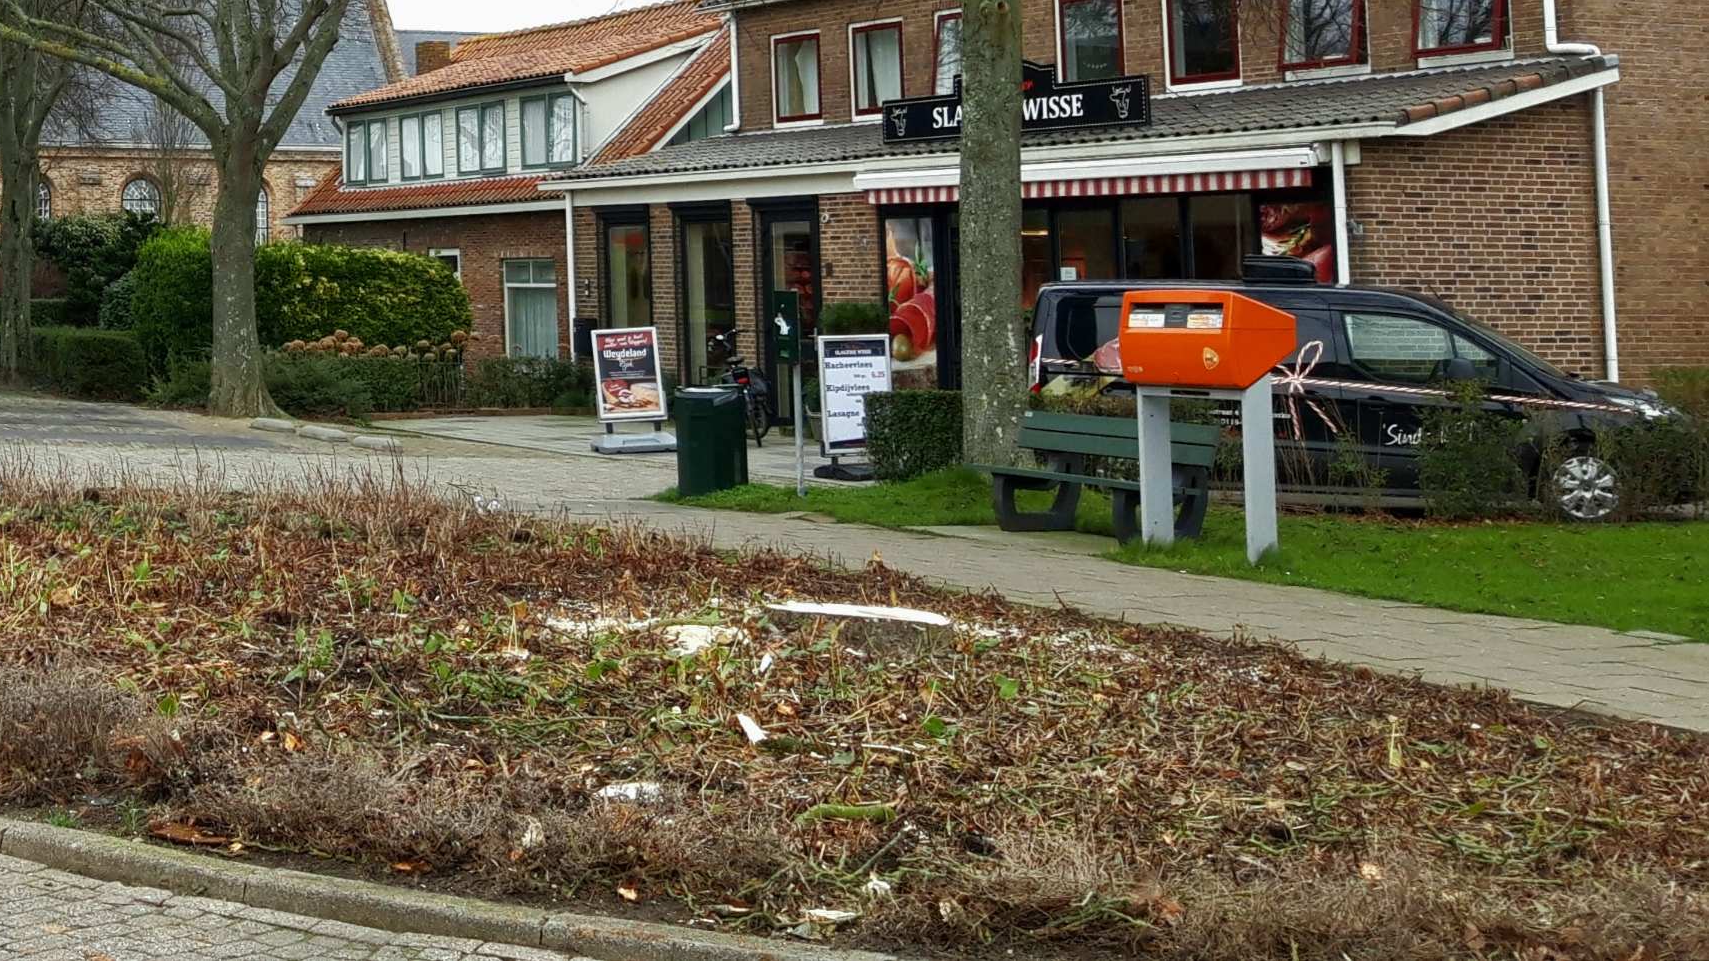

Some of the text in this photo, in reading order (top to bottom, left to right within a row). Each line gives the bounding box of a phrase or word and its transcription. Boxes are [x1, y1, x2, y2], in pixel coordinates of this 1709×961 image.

[1023, 94, 1084, 121] WISSE
[603, 348, 647, 360] Weydeland
[827, 410, 860, 418] Lasagne
